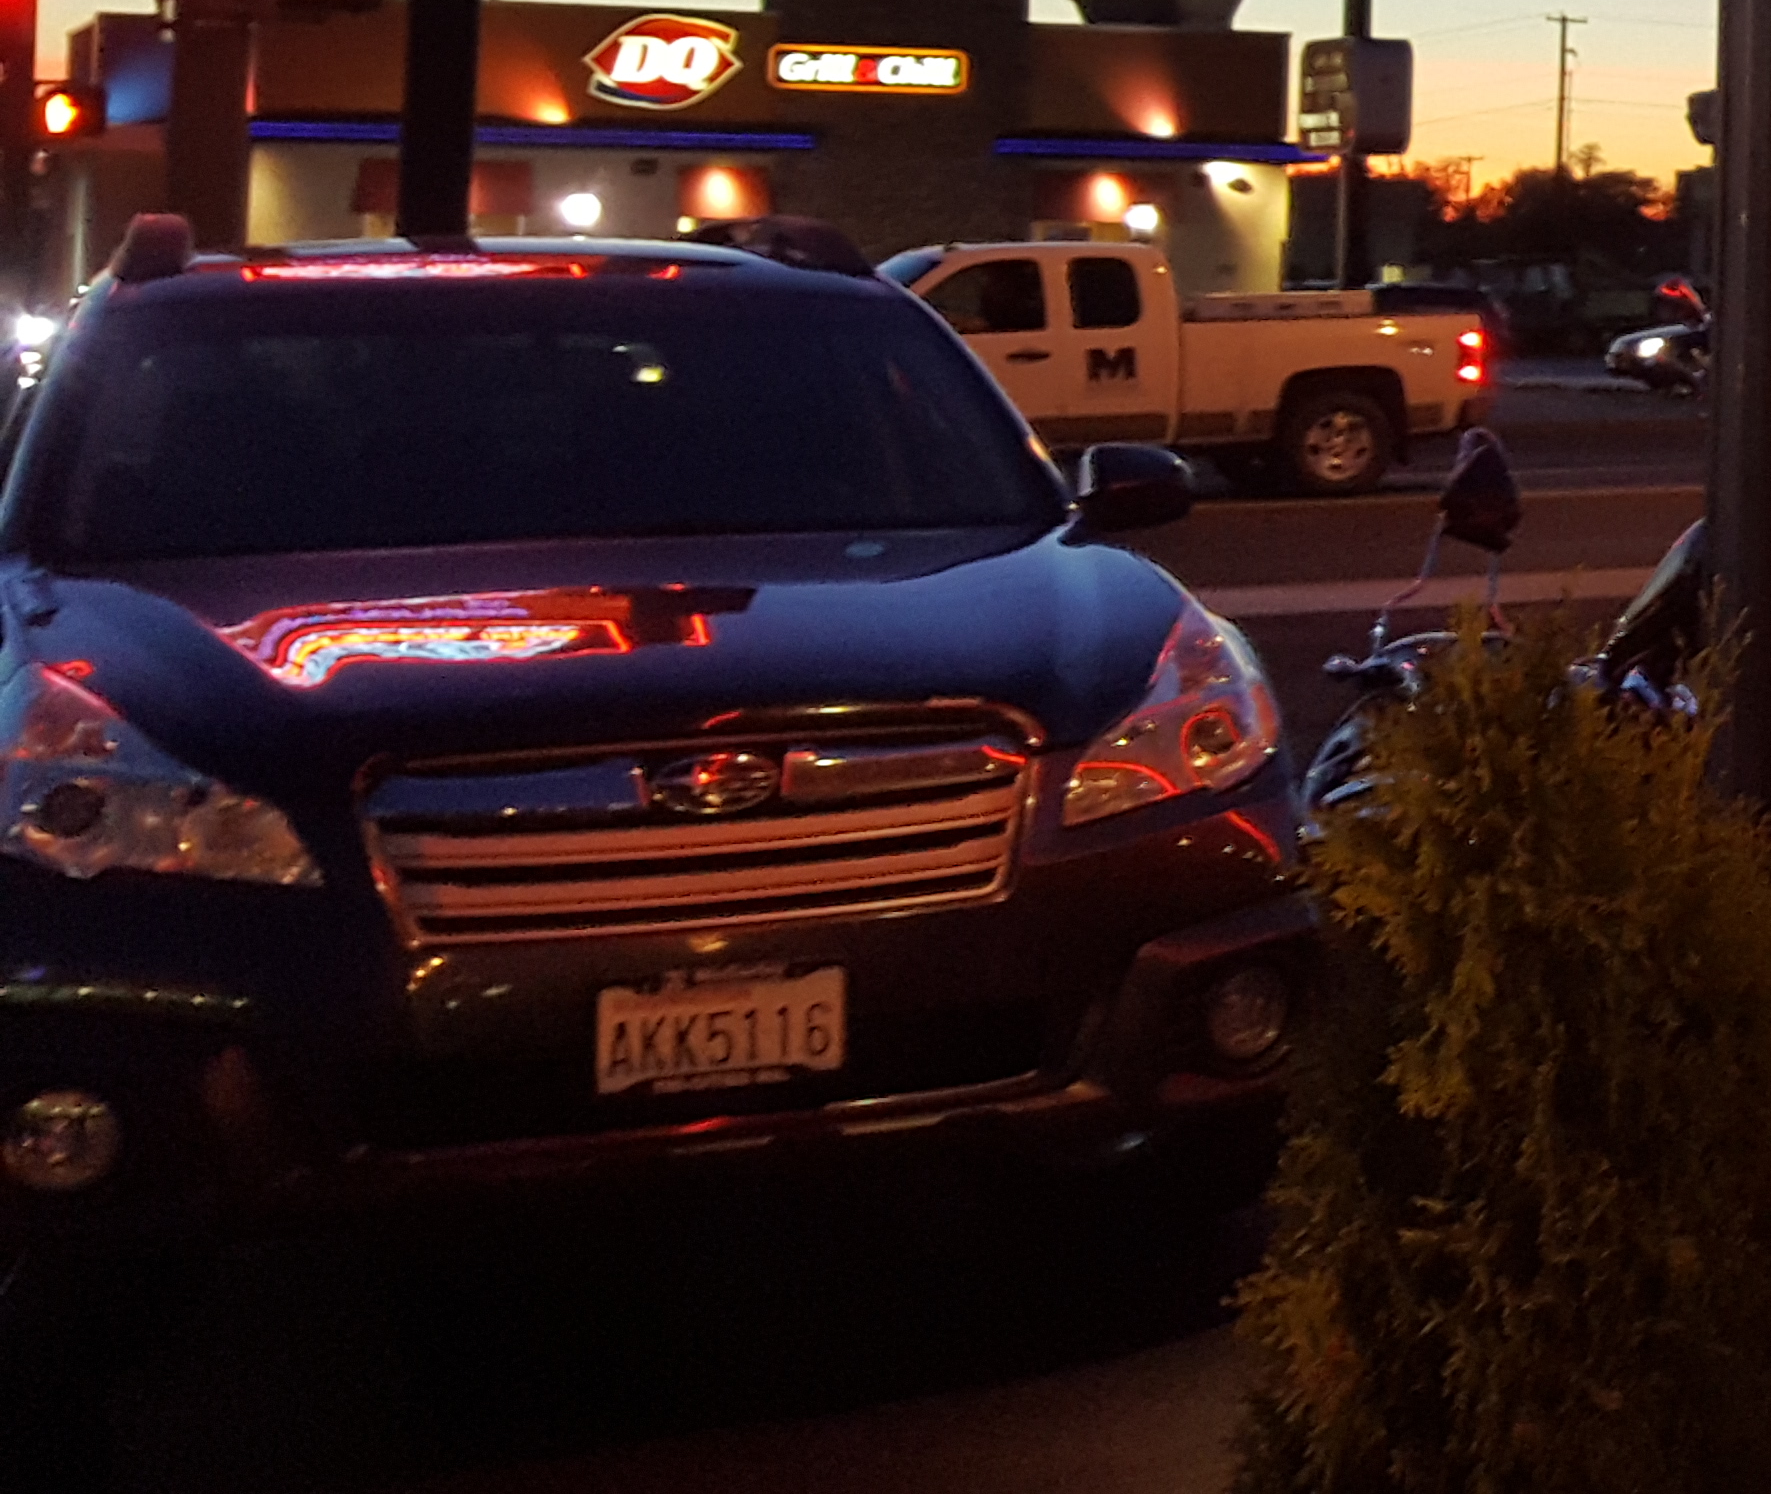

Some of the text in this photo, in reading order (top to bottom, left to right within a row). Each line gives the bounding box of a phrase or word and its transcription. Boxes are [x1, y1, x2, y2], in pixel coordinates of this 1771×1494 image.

[610, 35, 720, 91] DQ
[778, 53, 858, 83] Grill
[877, 55, 961, 86] Chill
[1086, 347, 1137, 380] M
[606, 1002, 833, 1079] AKK5116
